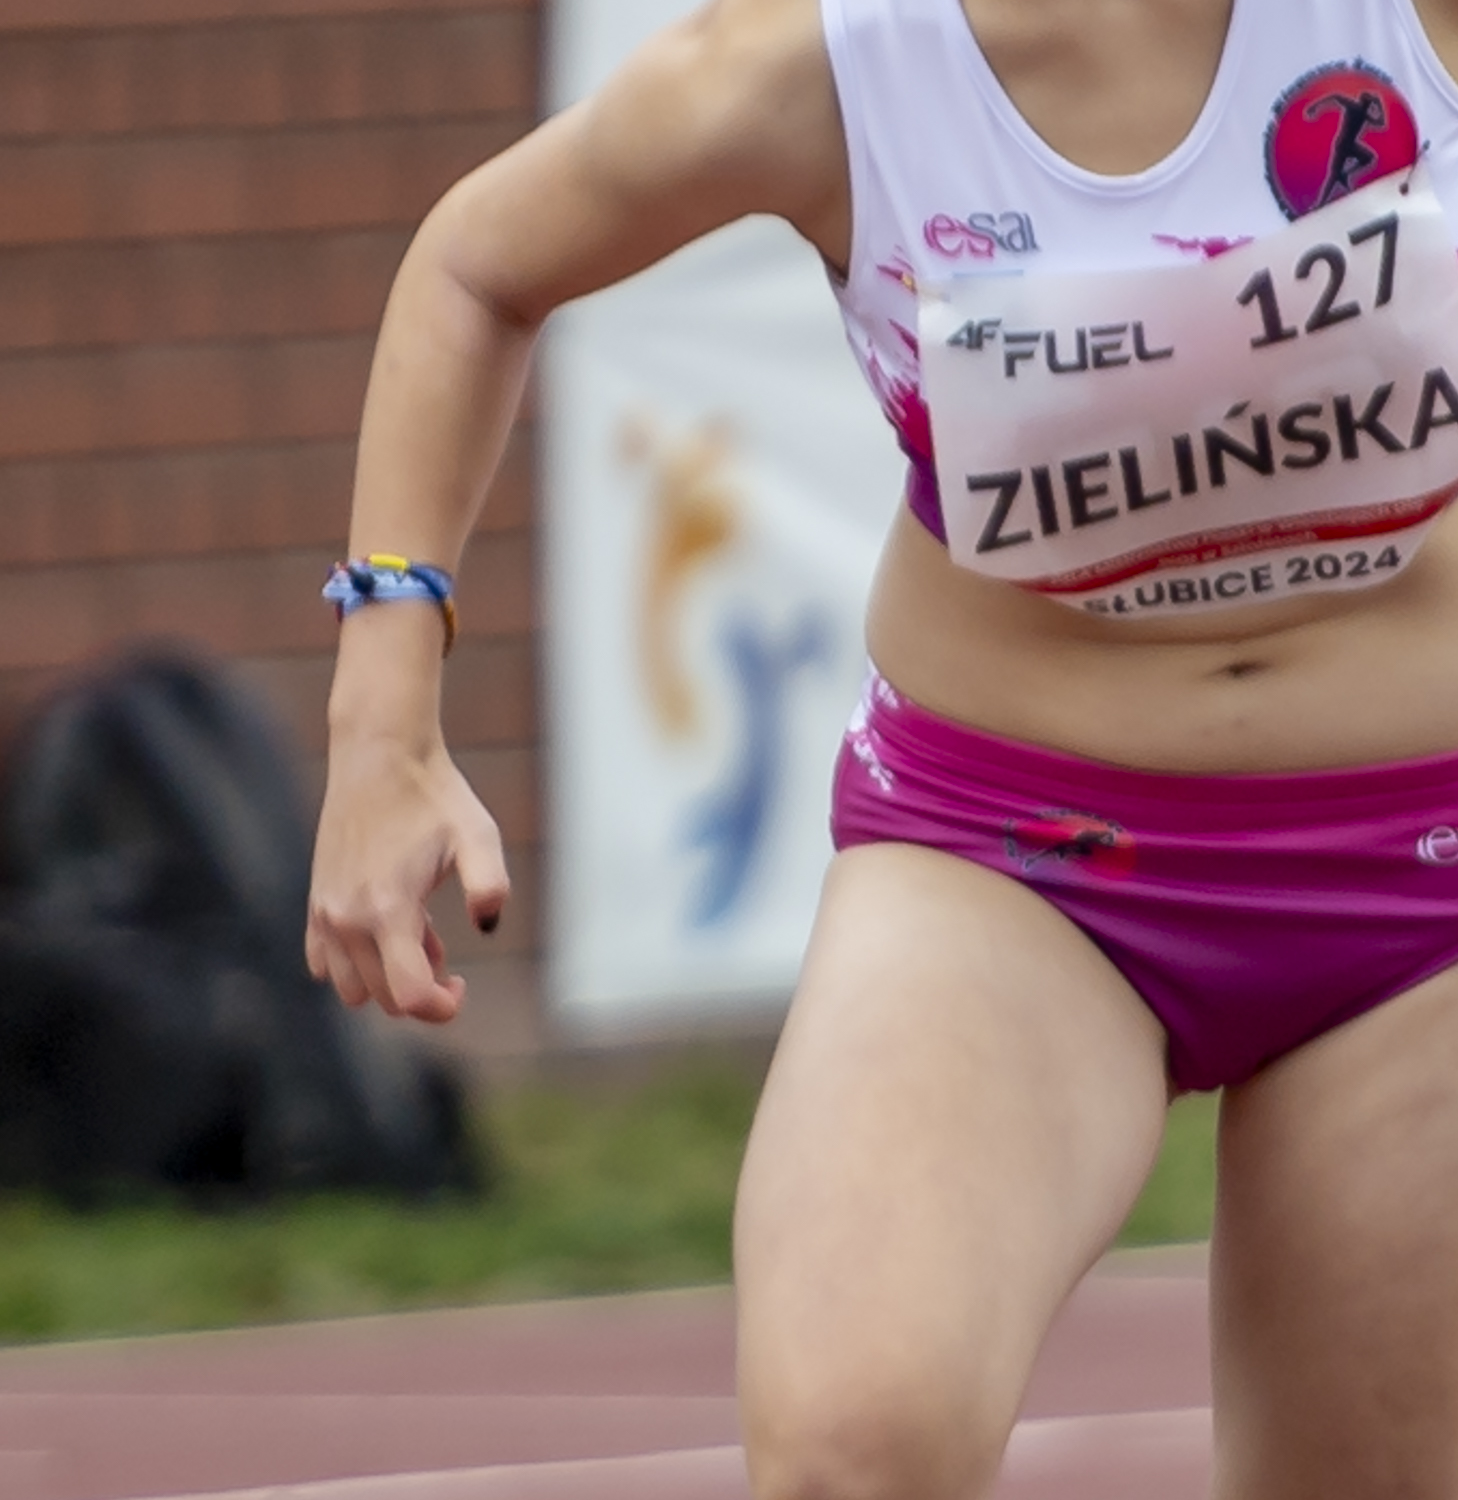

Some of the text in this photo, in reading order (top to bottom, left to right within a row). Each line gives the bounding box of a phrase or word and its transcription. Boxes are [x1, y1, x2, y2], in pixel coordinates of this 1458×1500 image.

[1003, 319, 1175, 379] FUEL
[1236, 210, 1402, 351] 127
[1285, 544, 1402, 585] 2024
